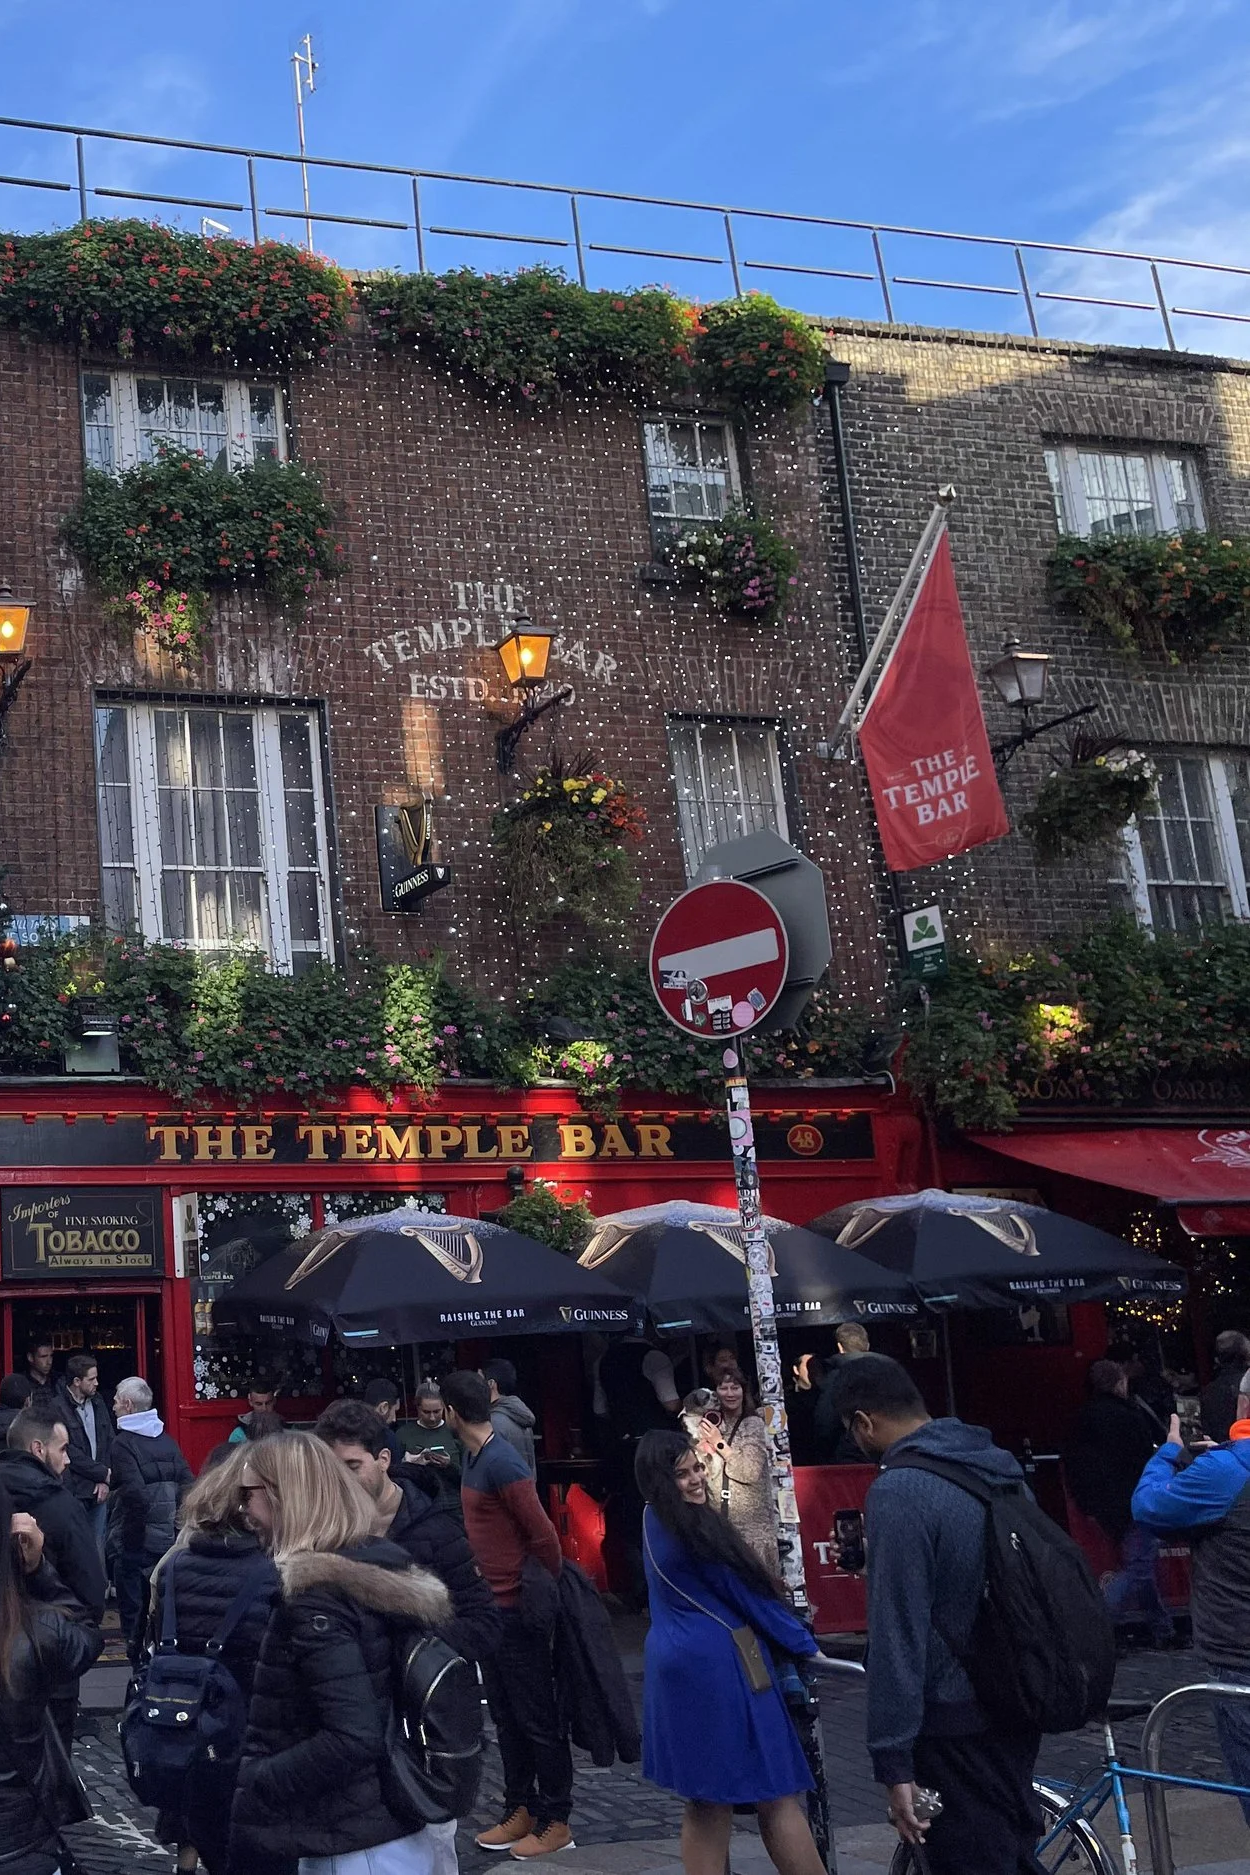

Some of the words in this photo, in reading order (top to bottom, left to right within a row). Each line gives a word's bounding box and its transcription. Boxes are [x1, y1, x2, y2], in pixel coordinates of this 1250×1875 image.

[450, 581, 527, 614] THE
[910, 749, 957, 777] THE
[882, 755, 981, 810] TEMPLE
[916, 790, 969, 826] BAR
[394, 869, 430, 898] GUINNESS
[149, 1125, 276, 1161] THE
[298, 1124, 534, 1160] TEMPLE
[558, 1123, 675, 1159] BAR
[791, 1130, 815, 1150] 48
[8, 1194, 71, 1222] Importers
[47, 1211, 59, 1219] OF
[65, 1216, 89, 1226] FINE
[90, 1215, 139, 1226] SMOKING
[26, 1222, 141, 1264] TOBACCO
[50, 1256, 94, 1266] Always
[99, 1256, 111, 1265] in
[115, 1255, 150, 1265] Stock
[1009, 1280, 1046, 1290] RAISING
[1048, 1278, 1066, 1288] THE
[1068, 1278, 1086, 1287] BAR
[1132, 1278, 1182, 1291] GUINNESS
[573, 1308, 629, 1321] GUINNESS
[785, 1302, 802, 1312] THE
[804, 1301, 822, 1311] BAR
[867, 1302, 919, 1315] GUINNESS
[440, 1311, 481, 1323] RAISING
[484, 1309, 502, 1319] THE
[506, 1308, 526, 1318] BAR
